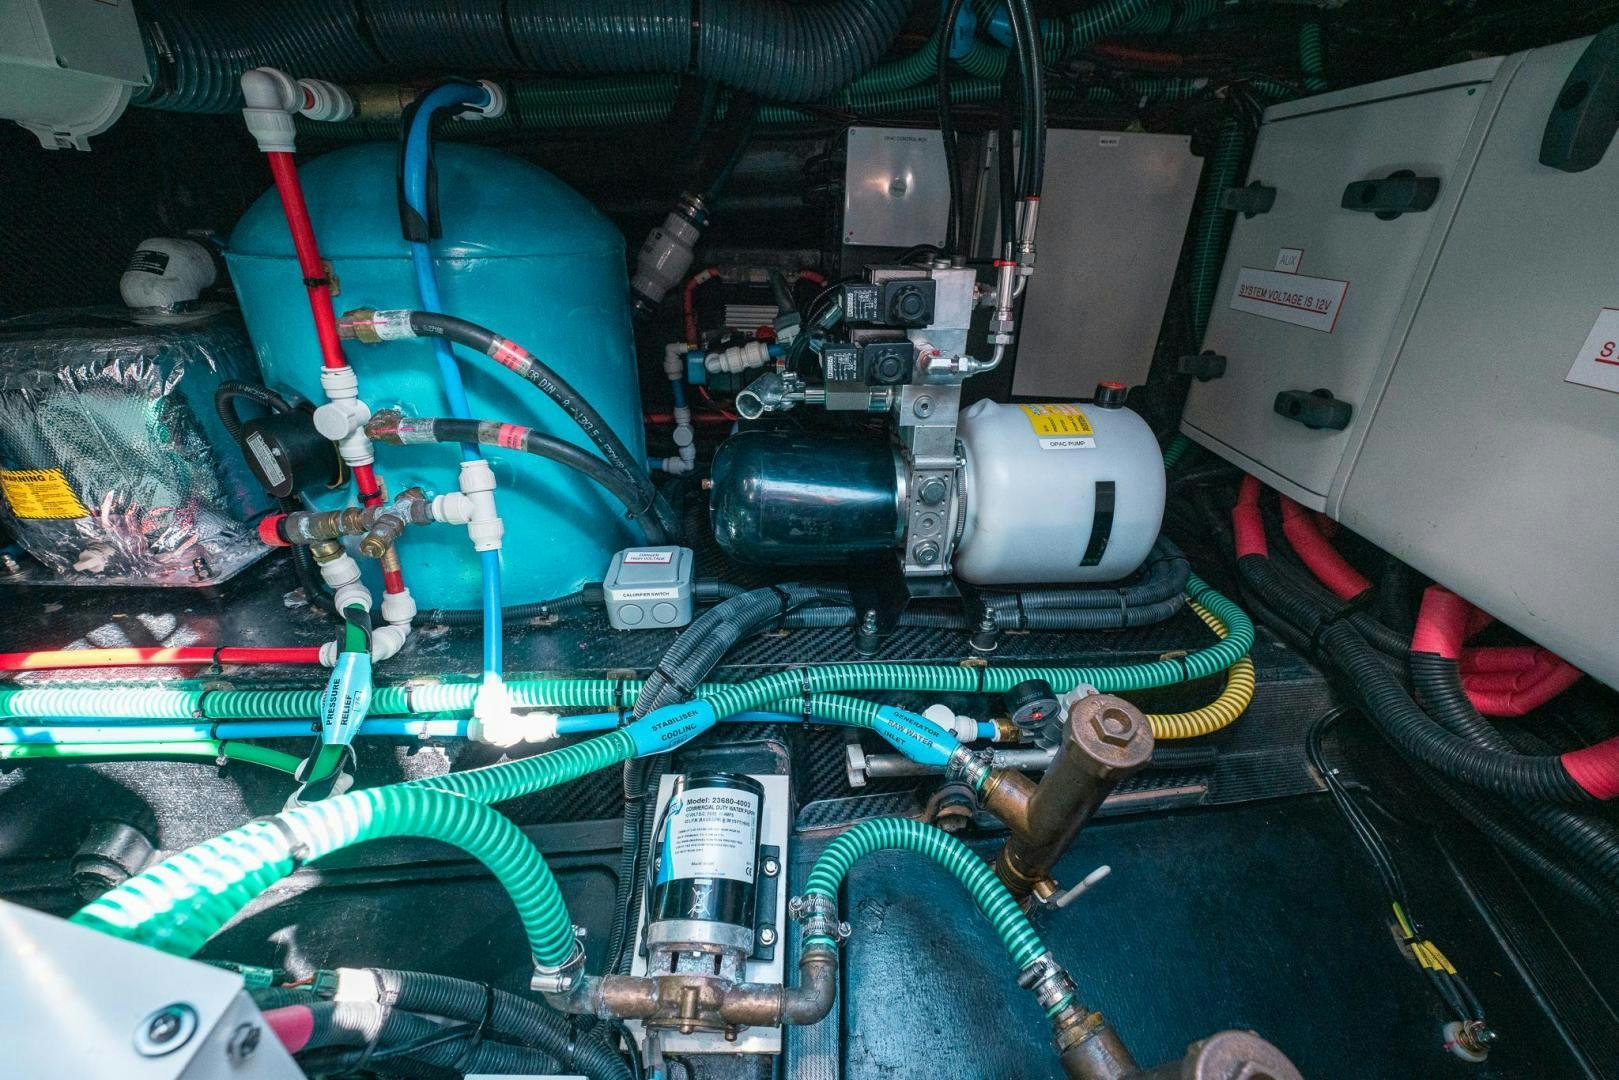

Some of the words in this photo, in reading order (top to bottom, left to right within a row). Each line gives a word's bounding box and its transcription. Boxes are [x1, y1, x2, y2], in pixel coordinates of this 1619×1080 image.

[1280, 255, 1297, 266] AUX
[1239, 284, 1268, 298] SYSTEM
[1268, 290, 1303, 306] VOLTAGE
[1304, 295, 1314, 308] IS
[1315, 299, 1332, 311] 12V
[540, 378, 556, 396] DIN
[326, 678, 340, 726] PRESSURE
[340, 694, 352, 726] RELIEF
[661, 723, 697, 742] COOLING
[888, 719, 906, 733] RAW
[906, 728, 934, 748] WATER
[894, 711, 940, 738] GENERATOR
[884, 730, 906, 746] INLET
[685, 804, 714, 812] COMMERCIAL
[686, 797, 710, 806] Model:
